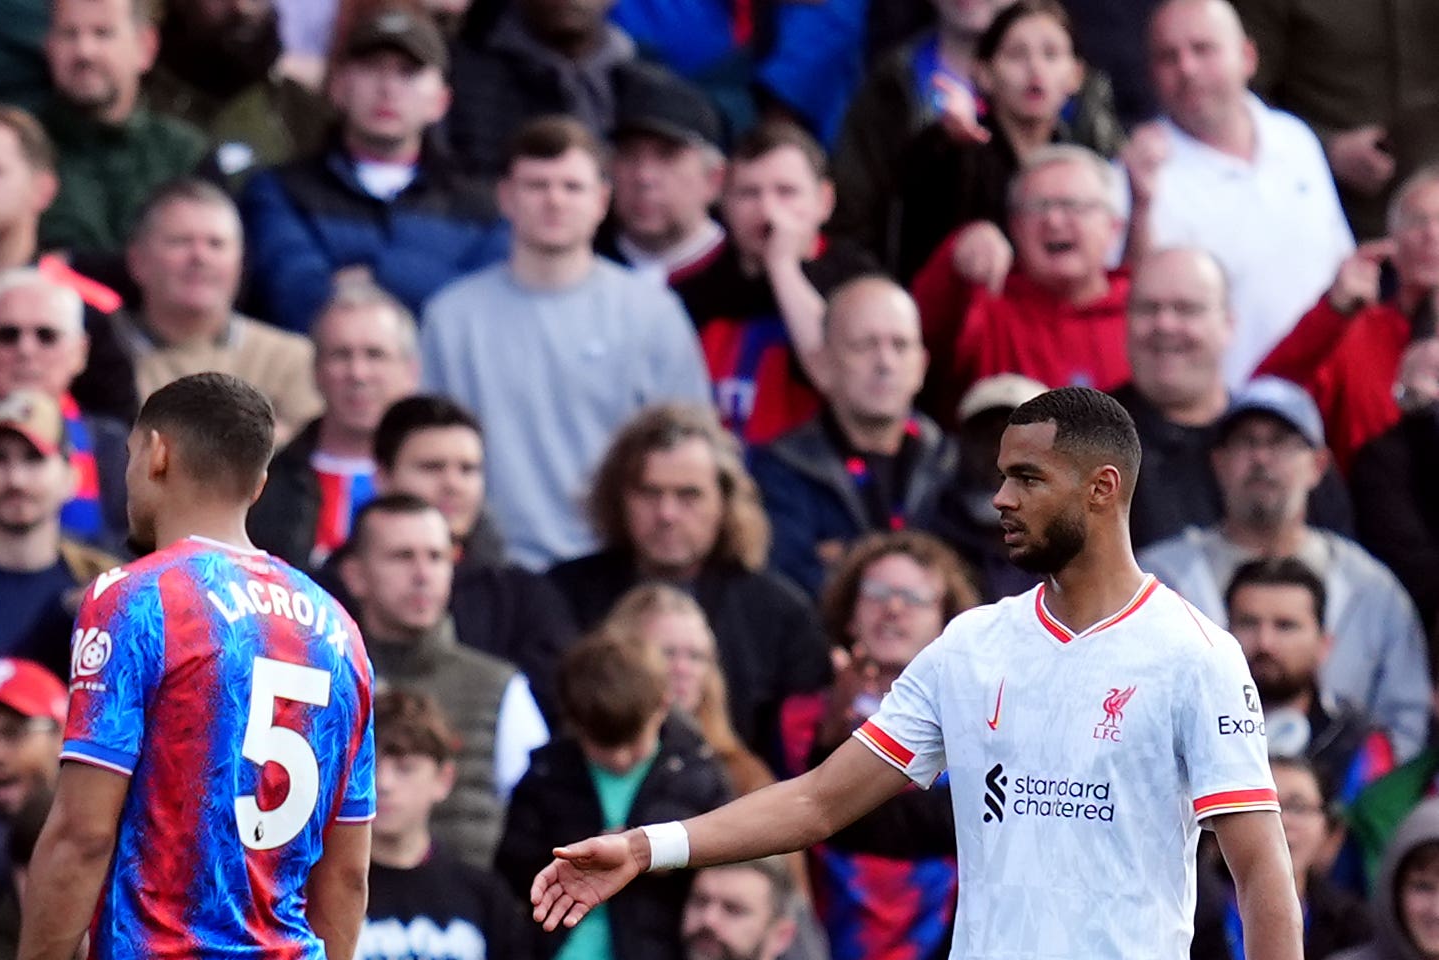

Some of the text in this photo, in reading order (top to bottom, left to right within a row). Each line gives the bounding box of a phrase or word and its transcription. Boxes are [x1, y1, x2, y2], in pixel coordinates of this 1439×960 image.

[207, 580, 349, 657] LACROIX
[234, 655, 332, 851] 5
[1013, 797, 1115, 822] chartered
[1014, 775, 1110, 800] standard
